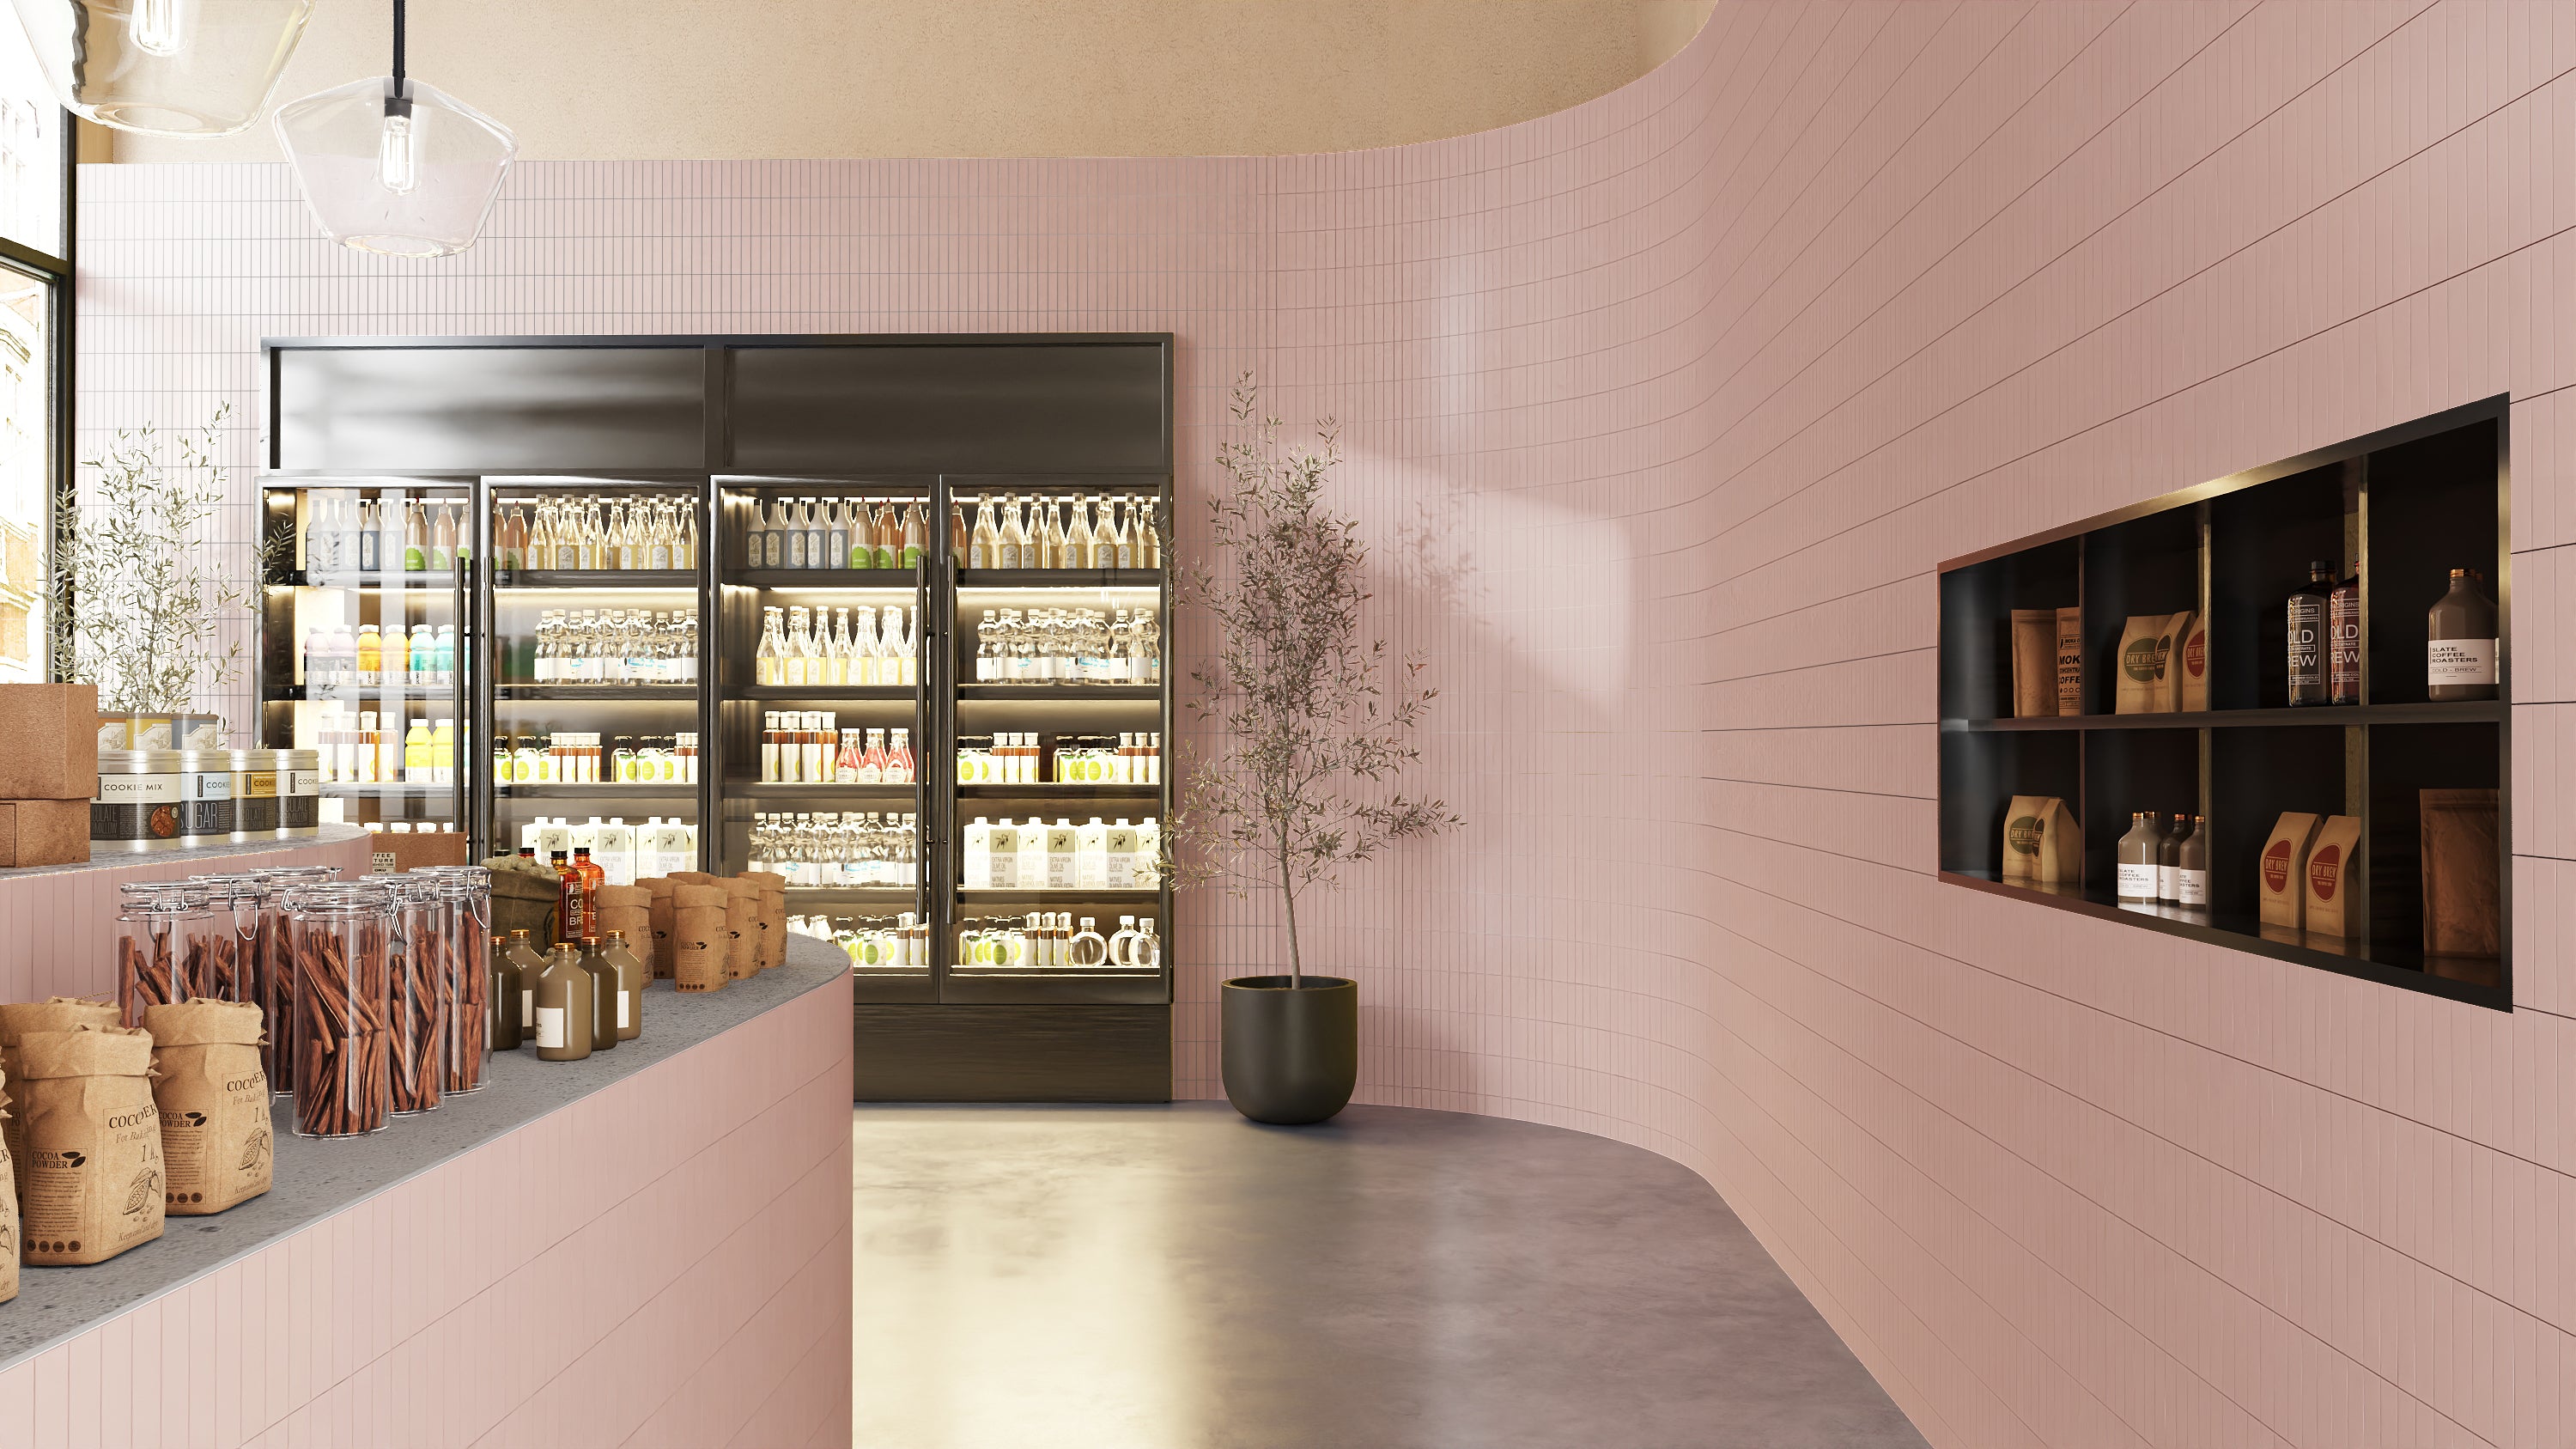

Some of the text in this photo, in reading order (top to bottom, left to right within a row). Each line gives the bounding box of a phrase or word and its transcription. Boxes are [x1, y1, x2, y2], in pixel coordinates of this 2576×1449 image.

[2287, 630, 2314, 644] OLD
[2330, 624, 2359, 639] OLD
[2059, 654, 2081, 666] MOK
[2126, 654, 2142, 664] DRY
[2059, 675, 2081, 685] OFFE
[2265, 858, 2275, 870] DRY
[2312, 864, 2336, 878] DRY BREW
[570, 898, 583, 910] CO
[569, 916, 583, 926] BR
[159, 1111, 184, 1120] COCOA
[32, 1151, 59, 1160] COCOA
[32, 1160, 68, 1169] POWDER
